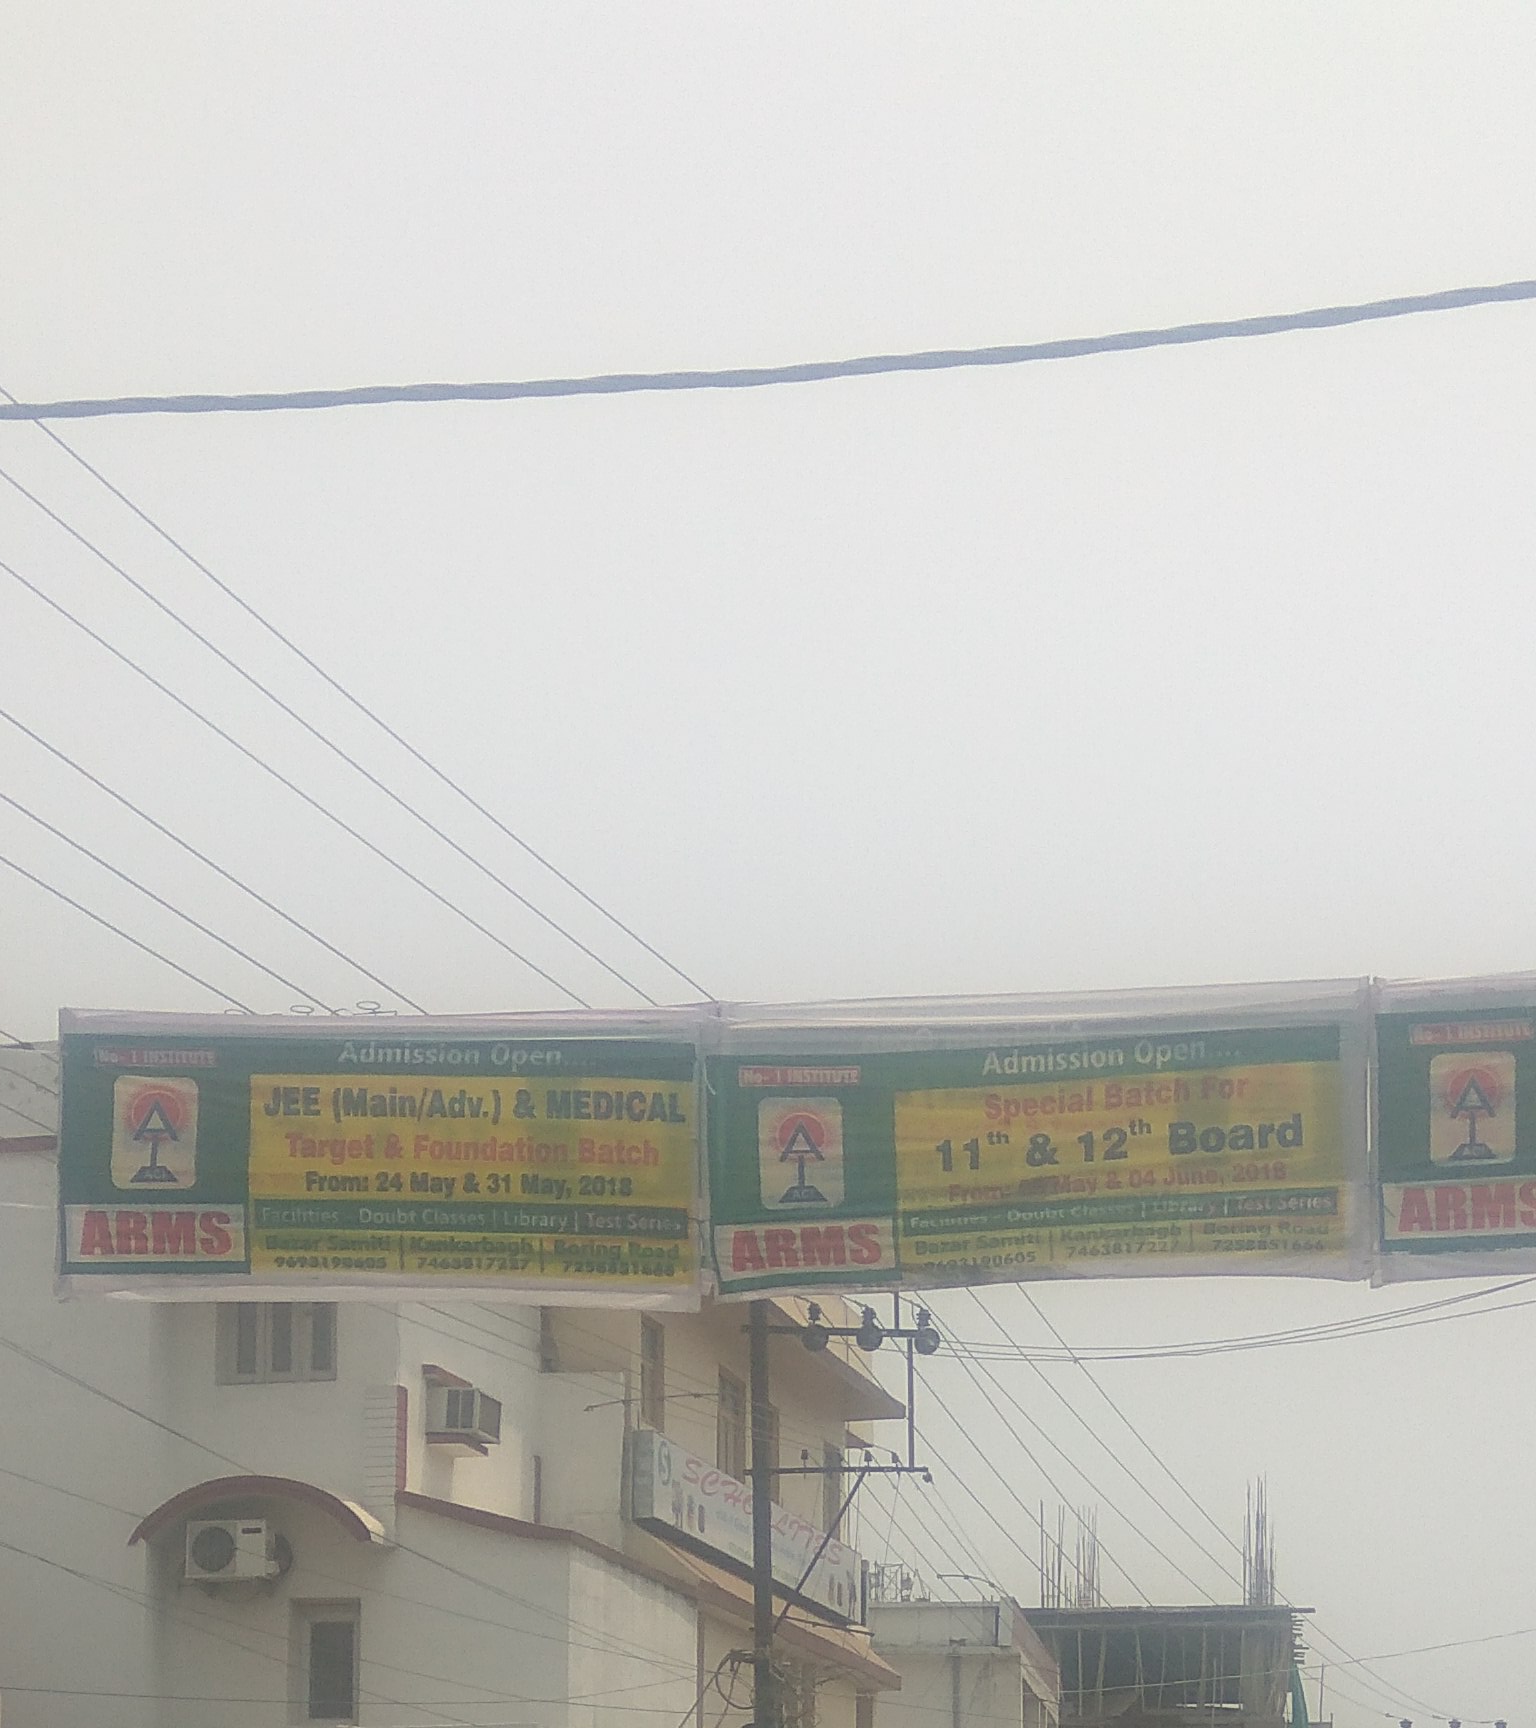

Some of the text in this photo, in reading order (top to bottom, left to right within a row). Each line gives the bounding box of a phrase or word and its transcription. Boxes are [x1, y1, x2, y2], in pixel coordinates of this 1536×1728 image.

[338, 1041, 480, 1066] Admission
[982, 1050, 1124, 1076] Admission
[264, 1086, 687, 1125] JEE (Main/Adv.) & MEDICAL
[983, 1075, 1250, 1125] Special Batch For
[284, 1132, 660, 1167] Target & Foundation Batch
[935, 1112, 1303, 1172] 11th & 12th Board
[374, 1171, 404, 1193] 24
[409, 1171, 457, 1199] May
[462, 1171, 481, 1194] &
[485, 1172, 512, 1194] 31
[519, 1172, 573, 1200] May,
[577, 1174, 634, 1197] 2018
[1128, 1168, 1156, 1189] 04
[79, 1209, 234, 1256] ARMS
[262, 1206, 340, 1225] Facilities
[359, 1208, 416, 1226] Doubt
[421, 1207, 486, 1226] Classes
[503, 1209, 568, 1232] Library
[587, 1211, 623, 1229] Test
[731, 1223, 882, 1272] ARMS
